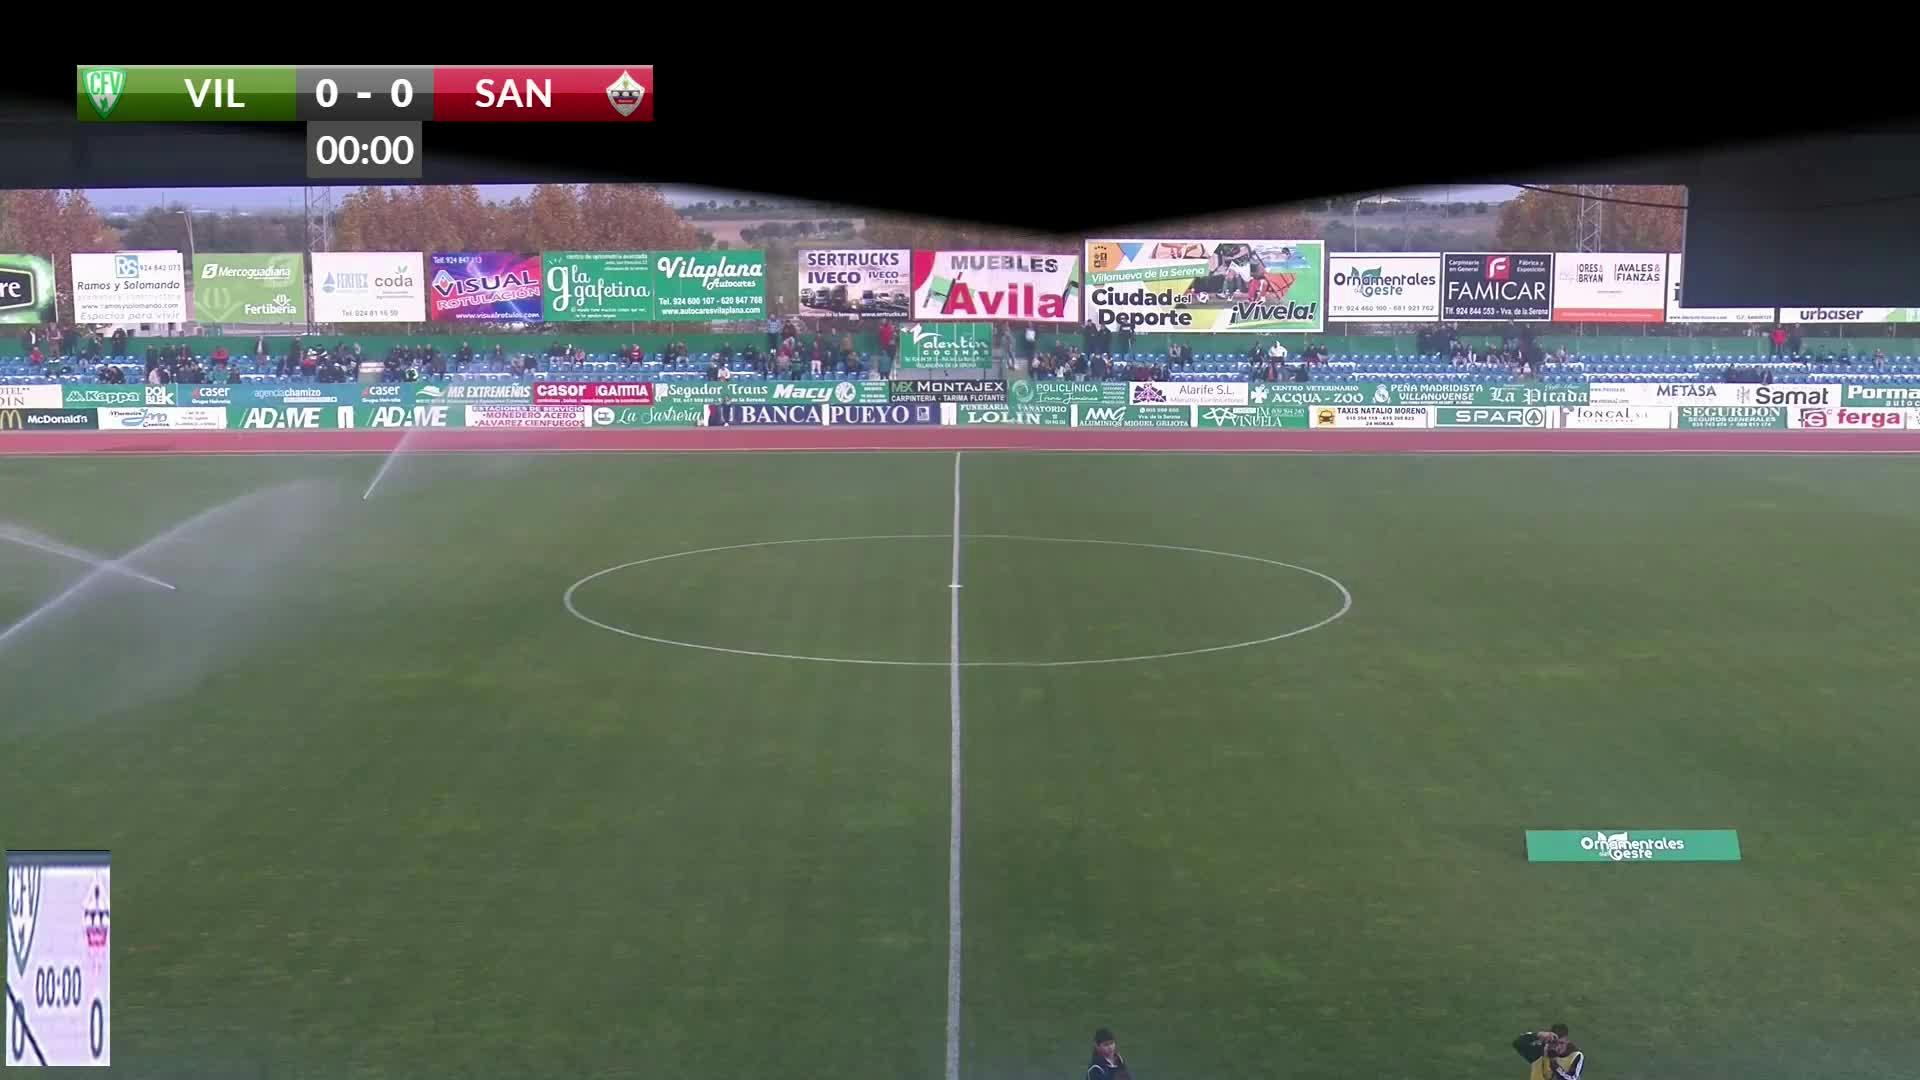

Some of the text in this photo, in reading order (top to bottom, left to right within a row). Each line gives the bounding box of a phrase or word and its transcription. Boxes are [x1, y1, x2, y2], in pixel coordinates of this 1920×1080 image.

[808, 253, 899, 266] SERTRUCKS
[951, 256, 1058, 273] MUEBLES
[218, 266, 290, 280] Mercoguadiana
[572, 264, 590, 283] la
[657, 256, 762, 287] Vilaplana
[1092, 266, 1205, 283] Villanueva de la Serena
[1618, 264, 1653, 272] AVALES
[375, 275, 413, 287] coda
[434, 271, 538, 297] VISUAL
[707, 278, 756, 290] Autocares
[808, 271, 899, 284] IVECO IVECO
[1333, 272, 1436, 286] Ornamentales
[1578, 273, 1603, 283] BRYAN
[1617, 273, 1660, 282] FIANZAS
[78, 280, 180, 292] Ramos y Solomando
[574, 278, 650, 306] gafetina
[1448, 281, 1546, 300] FAMICAR
[436, 286, 540, 310] ROTULACIÓN
[702, 297, 715, 305] 107
[943, 272, 1064, 318] Ávila
[1091, 287, 1191, 306] Ciudad del
[244, 303, 296, 314] Fertiberia
[662, 306, 760, 315] www.autocaresvilaplana.com
[1230, 301, 1316, 325] ¡Vívela!
[1456, 307, 1468, 315] 924
[1528, 307, 1548, 315] Serena
[1800, 307, 1863, 320] urbaser
[128, 312, 153, 321] para
[156, 311, 181, 320] vivir
[1098, 309, 1192, 327] Deporte
[200, 387, 230, 397] caser
[370, 386, 400, 396] caser
[448, 386, 465, 397] MR
[537, 384, 648, 396] casor GAMMA
[668, 383, 768, 398] Segador Trans
[773, 384, 834, 402] Macy
[917, 381, 1004, 392] MONTAJEX
[1036, 382, 1098, 392] POLICLÍNICA
[1179, 385, 1234, 395] Alarife S.L.
[1391, 383, 1483, 392] PEÑA MADRIDISTA
[1657, 385, 1717, 396] METASA
[86, 391, 139, 403] Kappa
[943, 394, 968, 402] TARIMA
[1272, 393, 1364, 404] ACQUA ZOO
[1489, 387, 1588, 405] La Picada
[1756, 387, 1829, 405] Samat
[28, 414, 88, 423] McDonald's
[243, 407, 322, 428] ADAME
[371, 406, 449, 427] ADAME
[617, 406, 702, 425] La Sastrería
[741, 405, 909, 424] BANCA PUEYO
[967, 411, 1042, 425] LOLIN
[1456, 410, 1523, 423] SPAR
[1682, 407, 1780, 417] SEGURDON
[1838, 409, 1900, 428] ferga
[1231, 414, 1282, 427] VIÑUELA
[1580, 836, 1684, 850] Ornamentales
[1612, 848, 1652, 860] oeste
[36, 965, 81, 1008] 00:00
[90, 998, 103, 1060] 0
